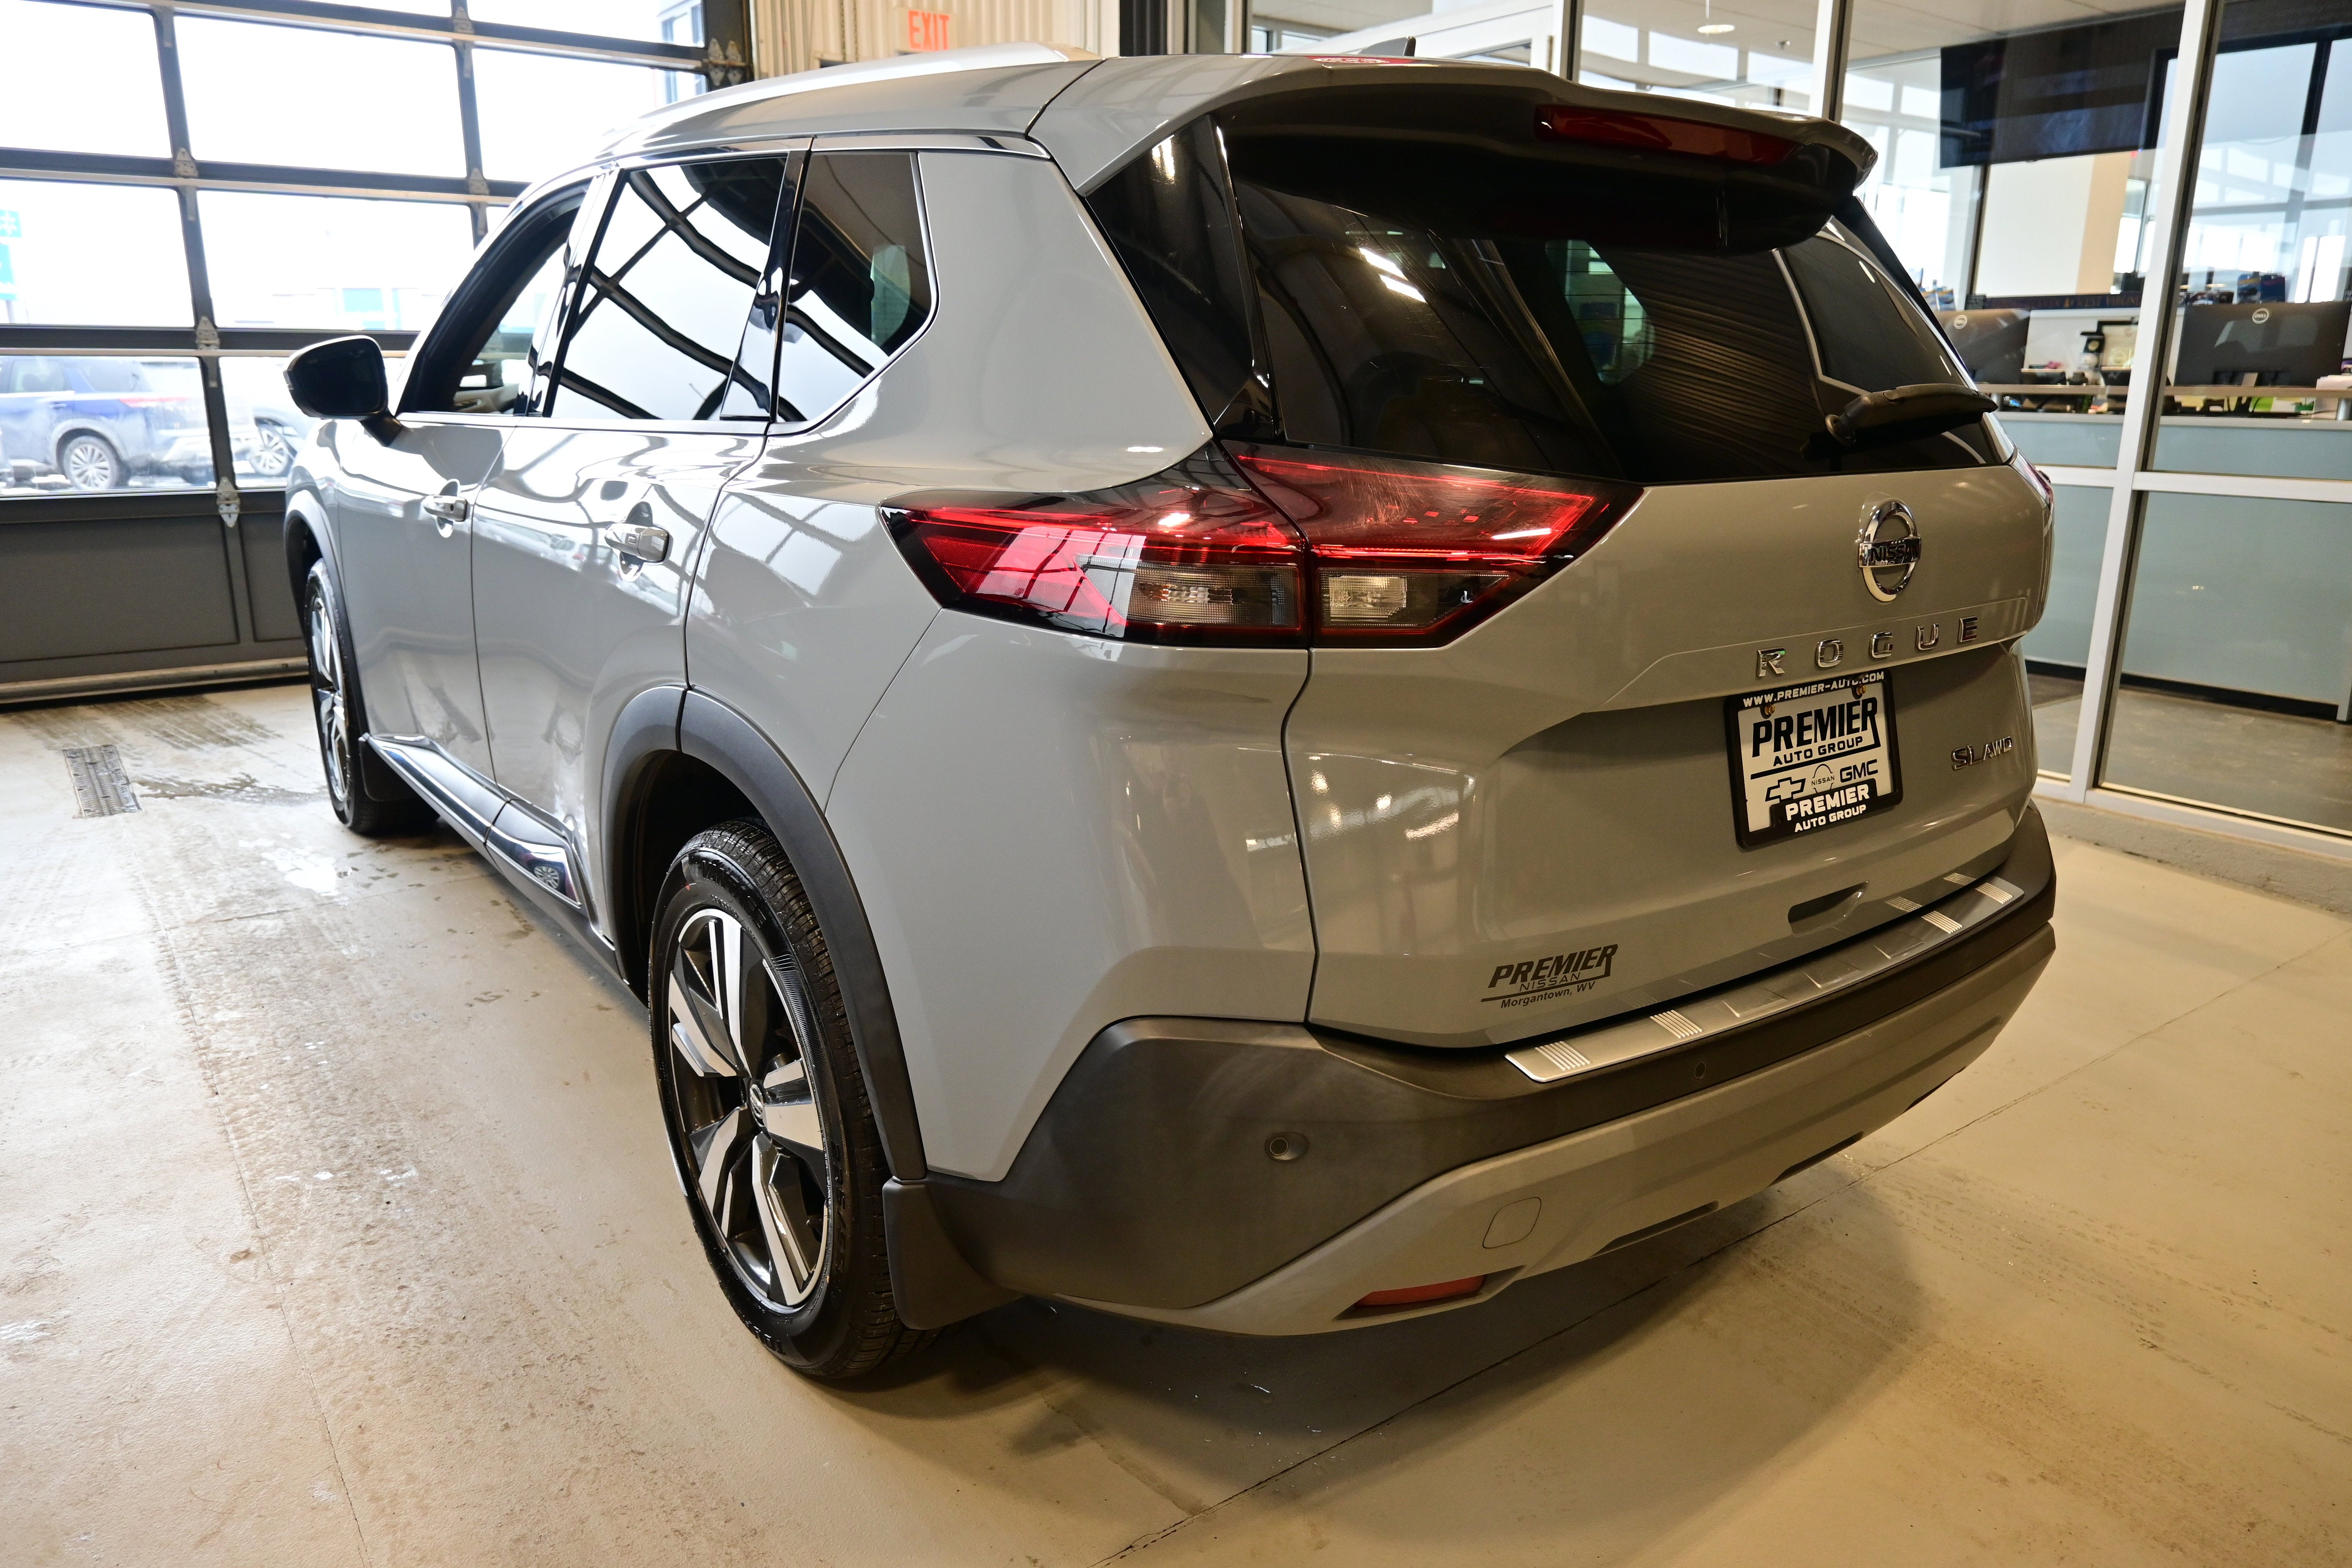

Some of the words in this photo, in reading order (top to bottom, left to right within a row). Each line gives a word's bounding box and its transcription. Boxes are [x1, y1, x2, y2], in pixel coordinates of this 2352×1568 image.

[908, 10, 950, 52] EXIT
[1870, 542, 1920, 562] NISSAN
[1756, 615, 1978, 677] ROGUE
[1752, 697, 1880, 758] PREMIER
[1773, 749, 1813, 767] AUTO
[1818, 736, 1863, 755] GROUP
[1951, 745, 1984, 770] SL
[1982, 736, 2012, 761] AWD
[1811, 775, 1835, 786] NISSAN
[1840, 759, 1878, 783] GMC
[1785, 784, 1870, 821] PREMIER
[1794, 816, 1826, 832] AUTO
[1829, 804, 1866, 822] GROUP
[1488, 944, 1618, 988] PREMIER
[1519, 972, 1580, 992] NISSAN
[1500, 987, 1573, 1008] Morgantown,
[1576, 981, 1595, 993] WV
